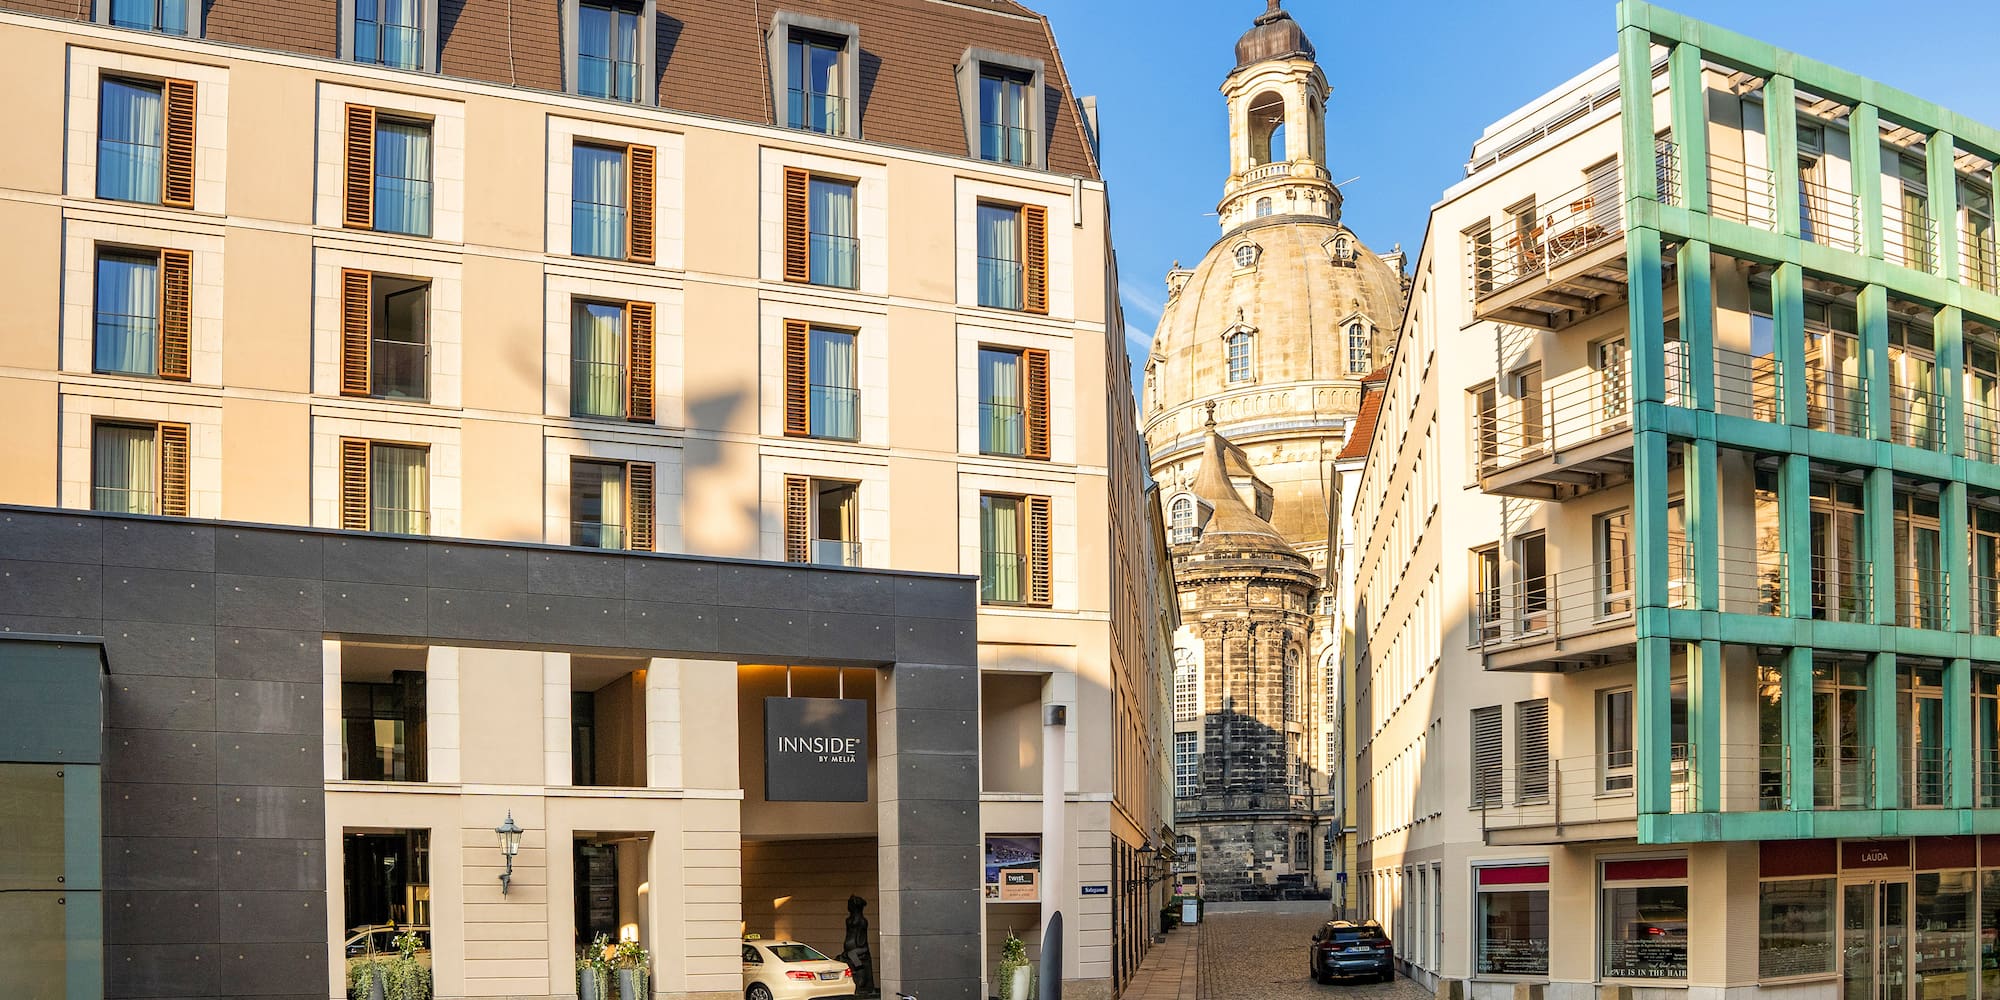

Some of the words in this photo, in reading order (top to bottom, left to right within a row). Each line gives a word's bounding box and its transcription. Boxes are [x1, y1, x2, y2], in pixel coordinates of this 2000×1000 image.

[1861, 852, 1888, 862] LAUDA
[1628, 968, 1635, 976] IS
[1638, 968, 1646, 976] IN
[1649, 969, 1665, 977] THE
